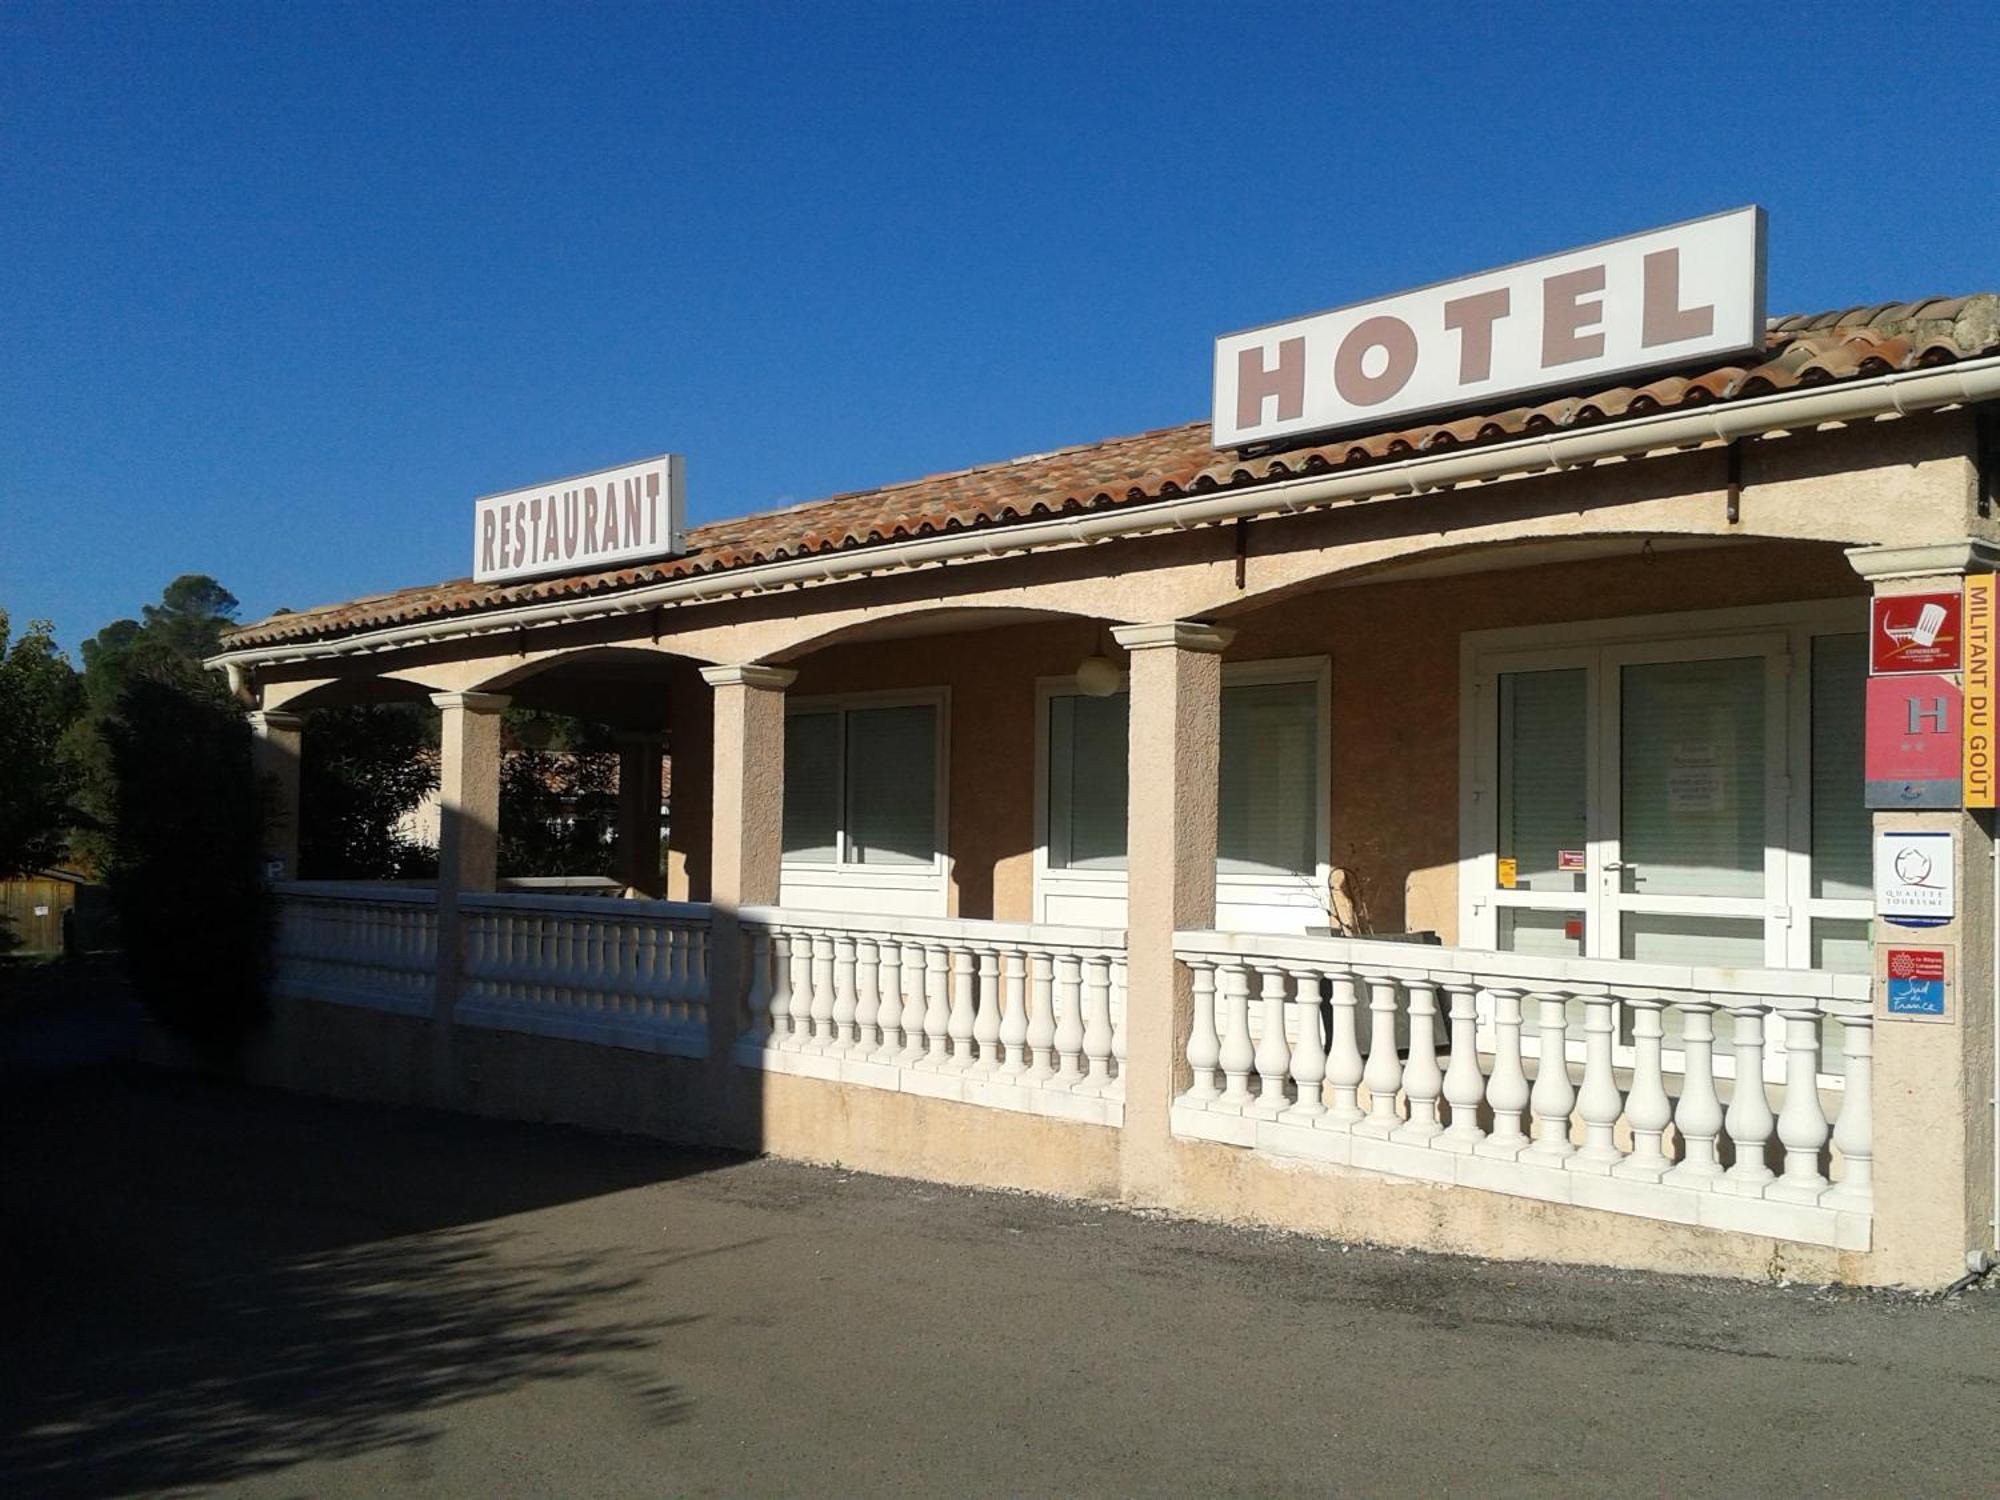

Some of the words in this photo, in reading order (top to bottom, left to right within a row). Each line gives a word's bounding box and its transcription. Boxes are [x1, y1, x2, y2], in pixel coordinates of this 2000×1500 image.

[1236, 247, 1714, 430] HOTEL
[482, 472, 659, 572] RESTAURANT
[1970, 586, 1988, 688] MILITANT
[1904, 696, 1951, 735] H
[1970, 696, 1988, 727] DU
[1969, 735, 1991, 798] GOÛT
[1893, 996, 1939, 1012] France
[1898, 976, 1930, 996] Sud
